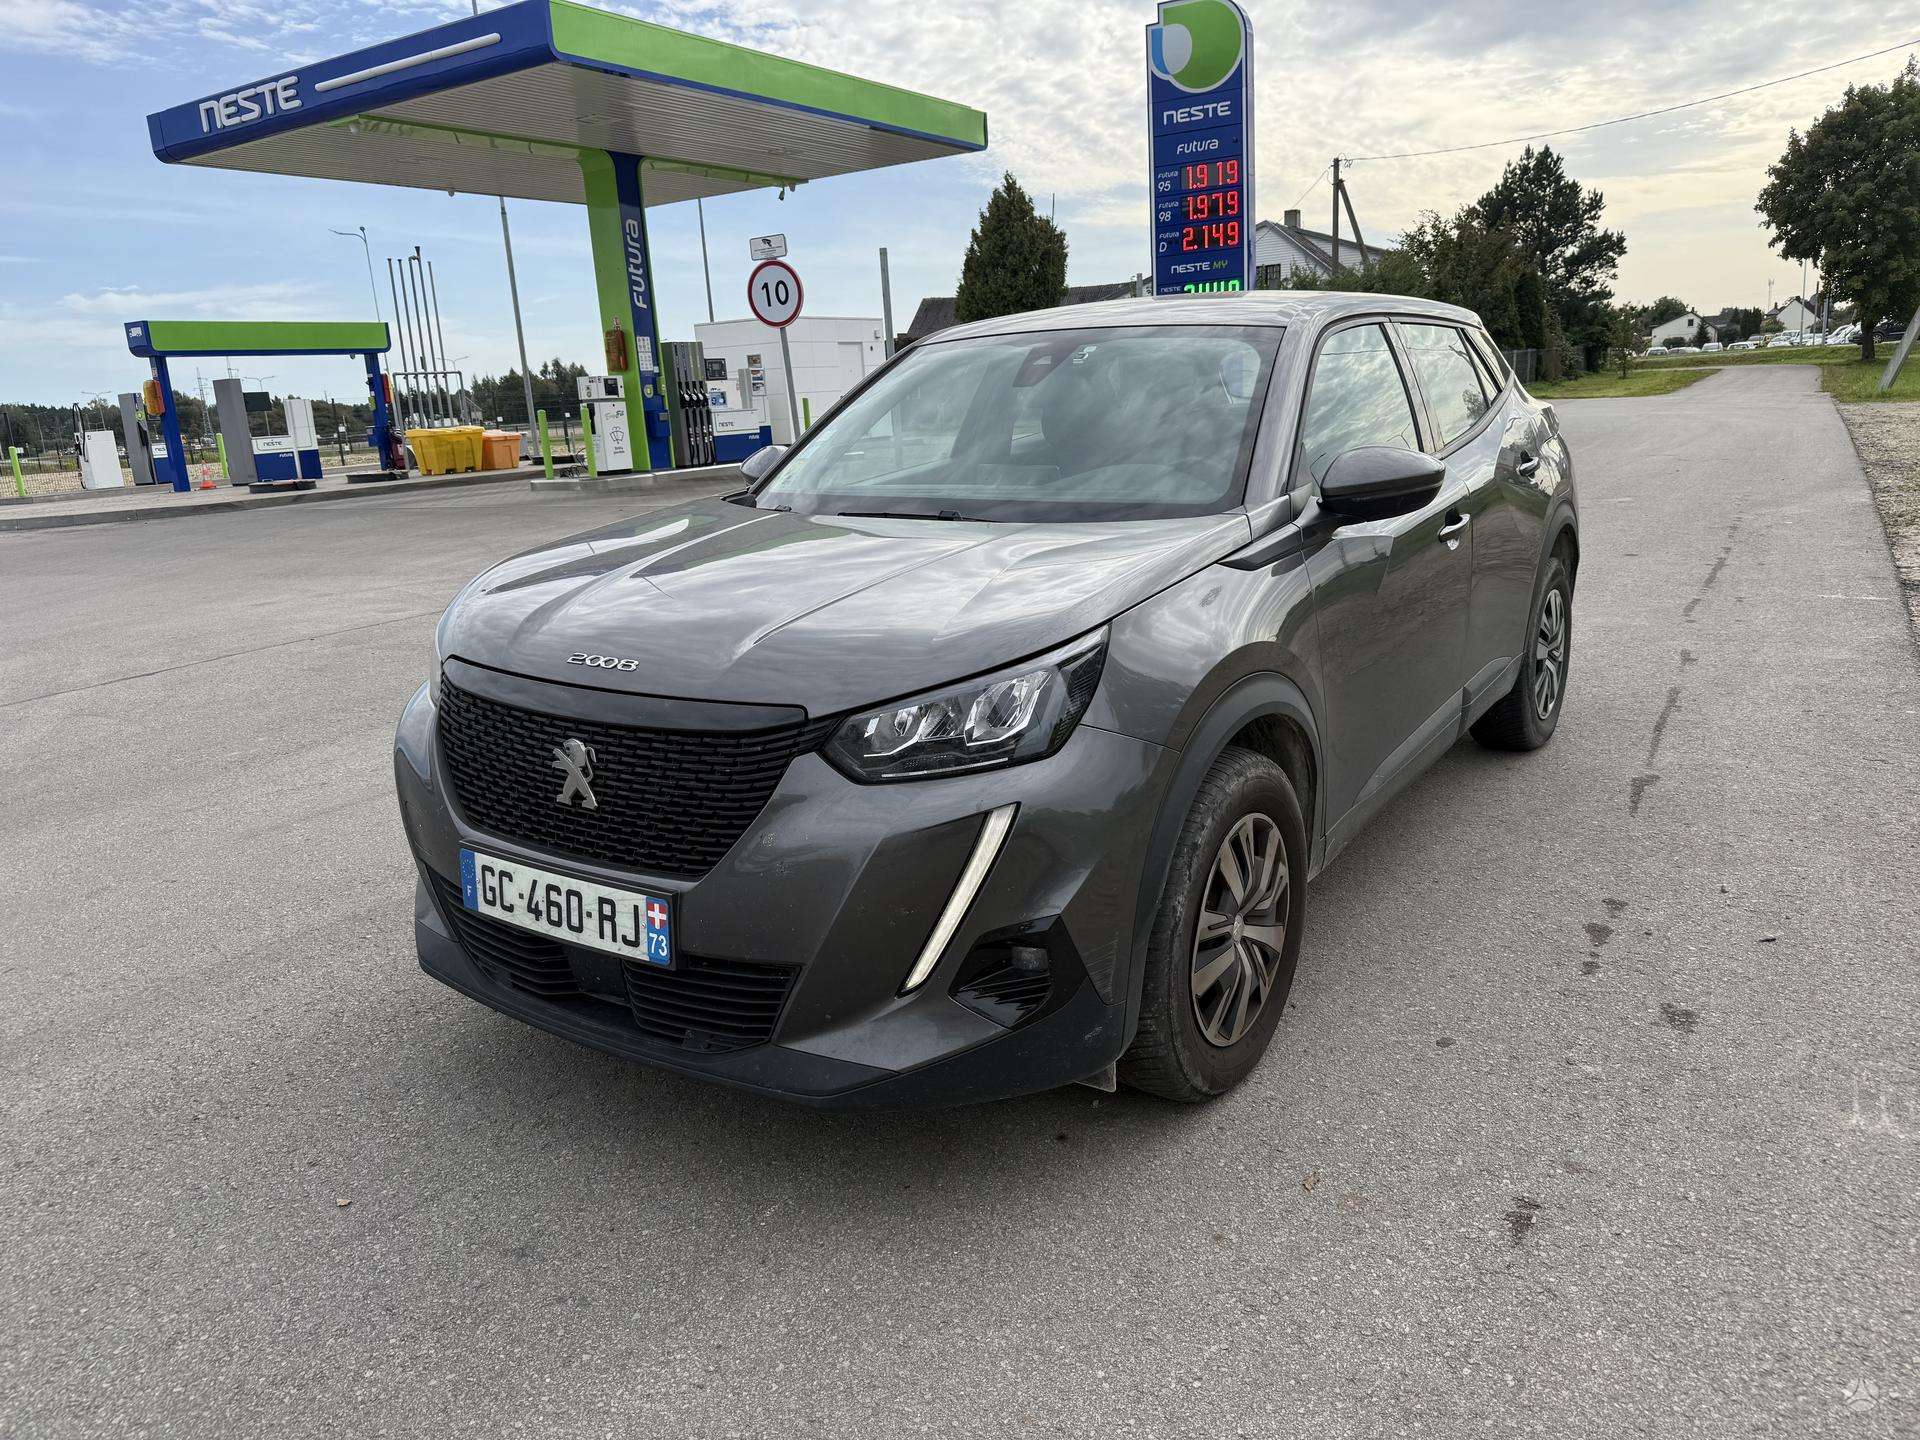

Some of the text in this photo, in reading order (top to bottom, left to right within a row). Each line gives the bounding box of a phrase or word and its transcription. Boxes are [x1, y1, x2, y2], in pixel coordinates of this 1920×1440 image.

[199, 75, 302, 133] NESTE
[1163, 101, 1231, 125] NESTE
[1158, 180, 1171, 192] 95
[1158, 211, 1171, 222] 98
[1187, 191, 1238, 220] 1.979
[1159, 241, 1168, 253] D
[1182, 222, 1239, 251] 2.149
[761, 279, 790, 308] 10
[566, 652, 640, 672] 2008
[649, 932, 668, 957] 73
